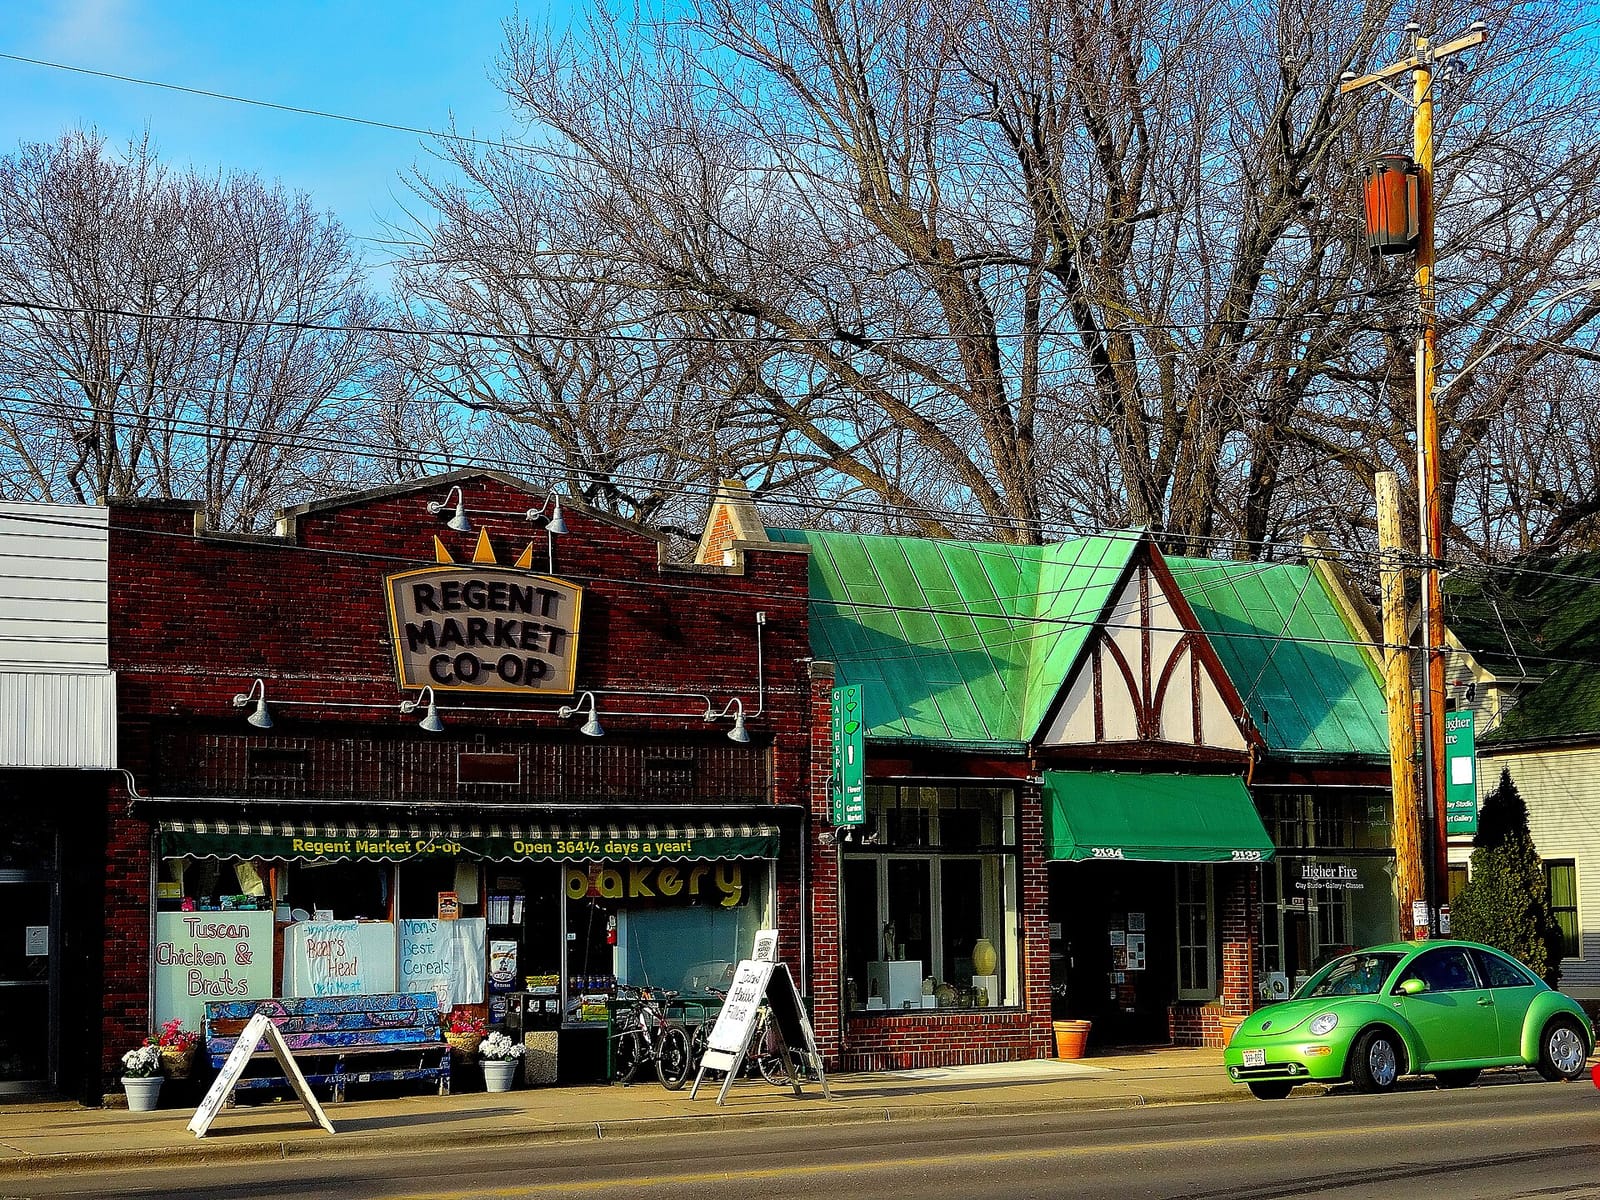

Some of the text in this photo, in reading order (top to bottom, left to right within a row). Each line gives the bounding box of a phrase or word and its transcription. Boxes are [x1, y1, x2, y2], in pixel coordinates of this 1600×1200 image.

[412, 579, 560, 615] REGENT
[405, 617, 567, 653] MARKET
[429, 652, 548, 687] CO-OP
[1446, 716, 1471, 732] igher
[1446, 733, 1458, 745] ire
[833, 691, 842, 822] GATHERINGS
[1456, 800, 1473, 808] Studio
[1454, 815, 1473, 823] Gallery
[292, 838, 462, 855] Regent Market Co-op
[513, 841, 552, 856] Open
[604, 840, 639, 855] days
[642, 843, 651, 853] a
[655, 840, 692, 855] year!
[1302, 865, 1358, 880] Higher Fire
[566, 863, 742, 907] bakery
[1295, 882, 1306, 890] Clay
[1325, 882, 1342, 890] Gallery
[183, 917, 250, 939] Tuscan
[403, 920, 437, 936] Mom's
[156, 942, 254, 967] Chicken &
[306, 937, 346, 959] Boar's
[328, 957, 358, 978] Head
[403, 959, 451, 976] Cereals
[187, 968, 249, 996] Brats
